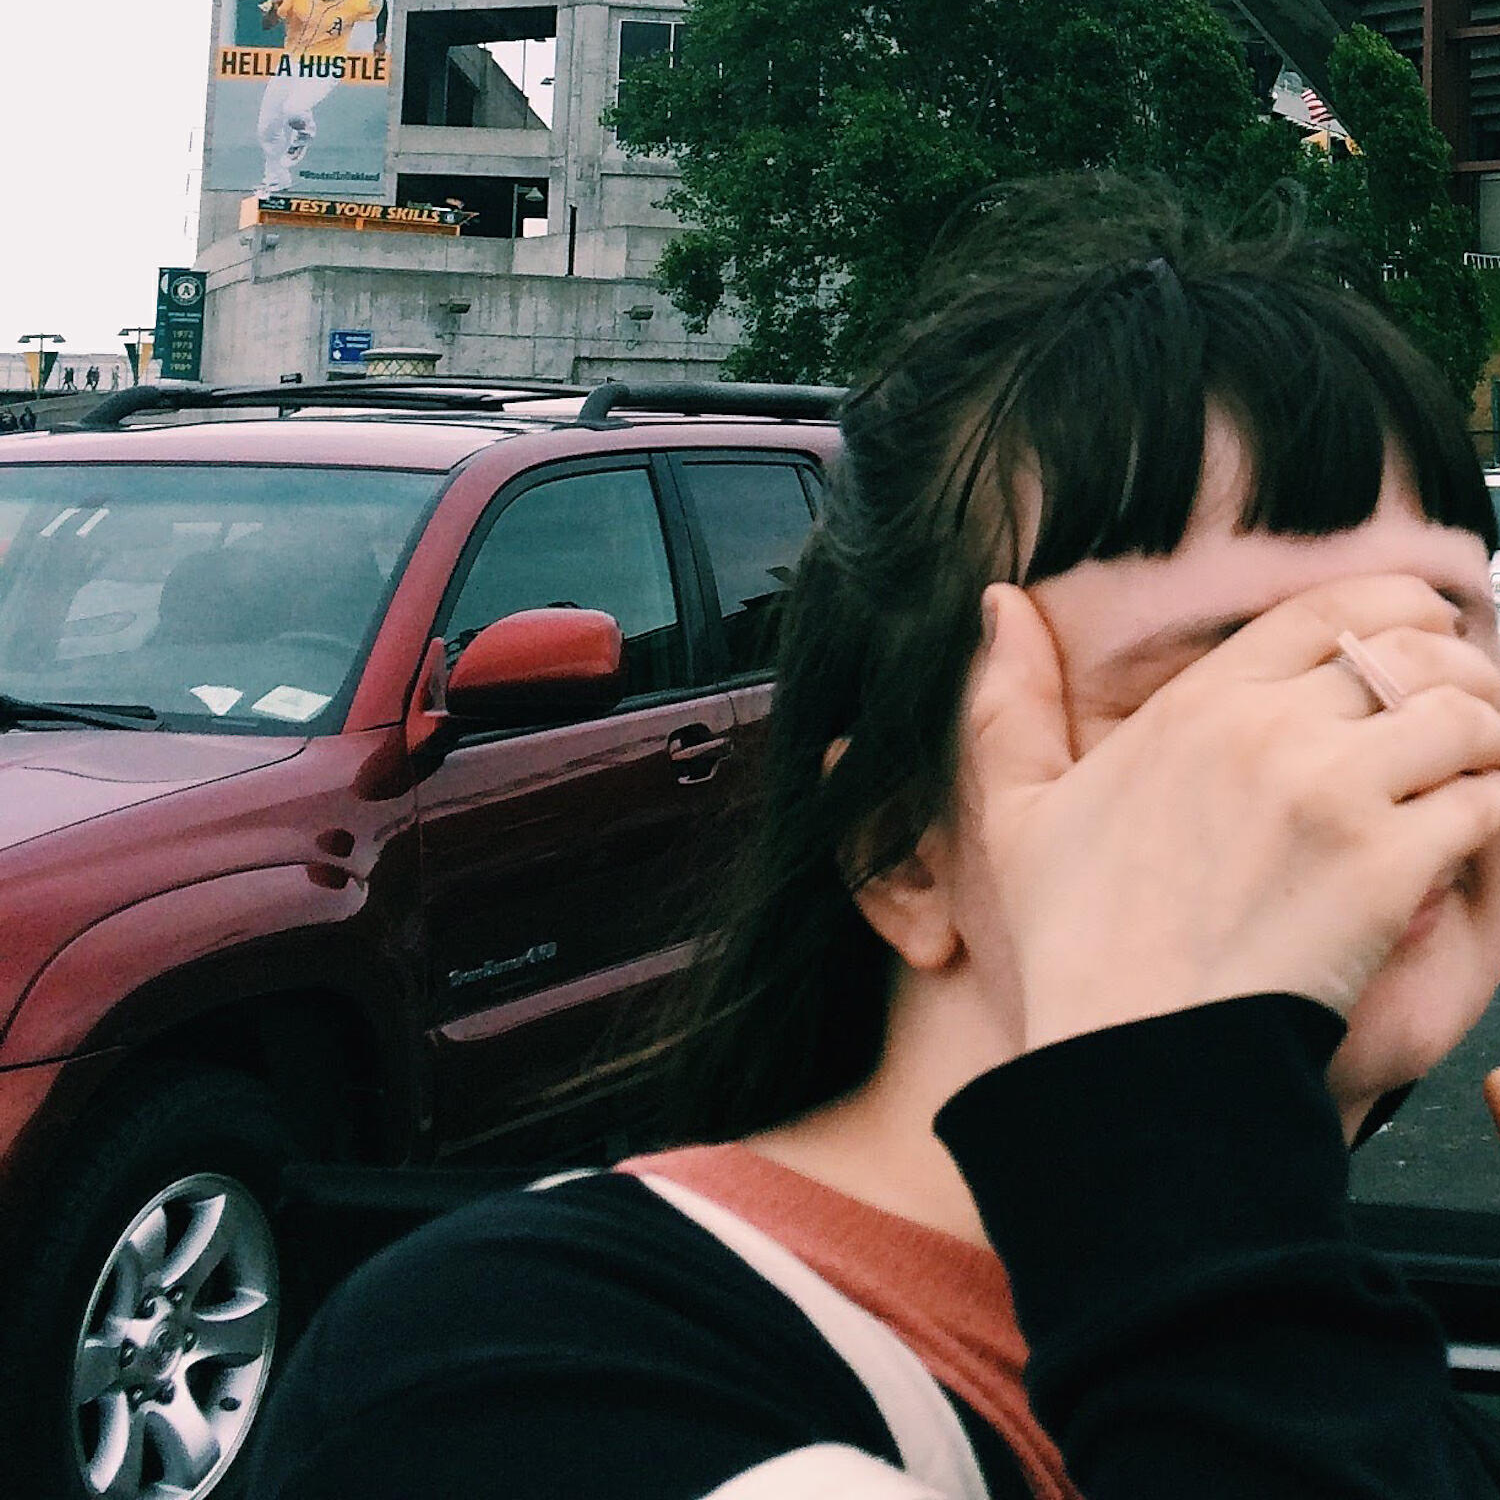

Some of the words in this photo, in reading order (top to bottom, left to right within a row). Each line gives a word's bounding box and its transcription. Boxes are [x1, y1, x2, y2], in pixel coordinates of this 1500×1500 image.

[221, 51, 292, 77] HELLA
[299, 53, 387, 81] HUSTLE
[288, 199, 333, 215] TEST
[334, 202, 383, 219] YOUR
[386, 206, 441, 223] SKILLS
